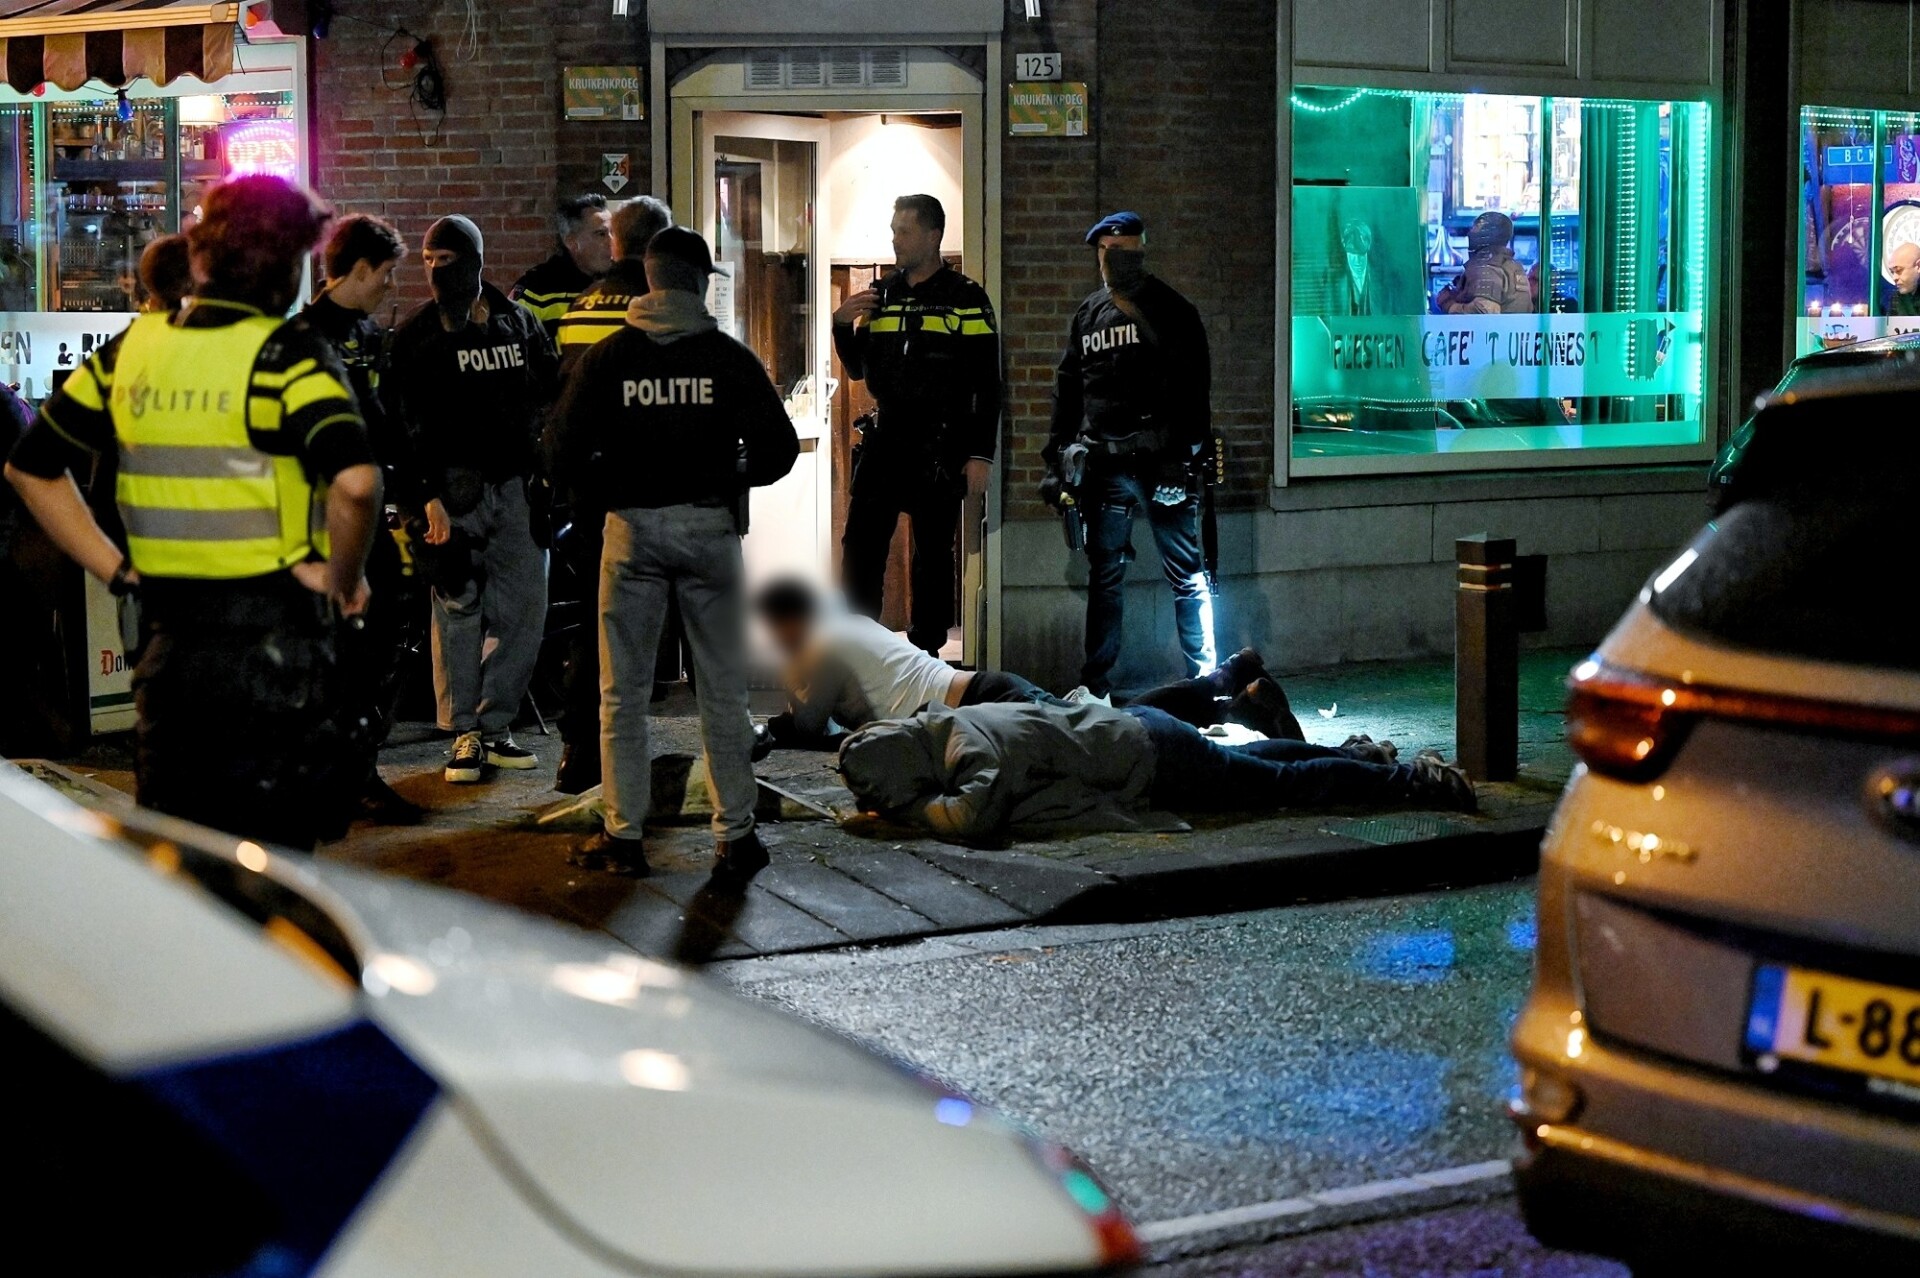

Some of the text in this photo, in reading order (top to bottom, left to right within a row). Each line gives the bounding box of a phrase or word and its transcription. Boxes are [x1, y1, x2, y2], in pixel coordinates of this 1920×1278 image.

[1024, 57, 1054, 77] 125
[568, 78, 639, 90] KRUIKENKROEG
[1013, 93, 1083, 106] KRUIKENKROEG
[228, 140, 295, 164] OPEN
[604, 160, 627, 176] 125
[457, 343, 525, 372] POLITIE
[622, 377, 714, 407] POLITIE
